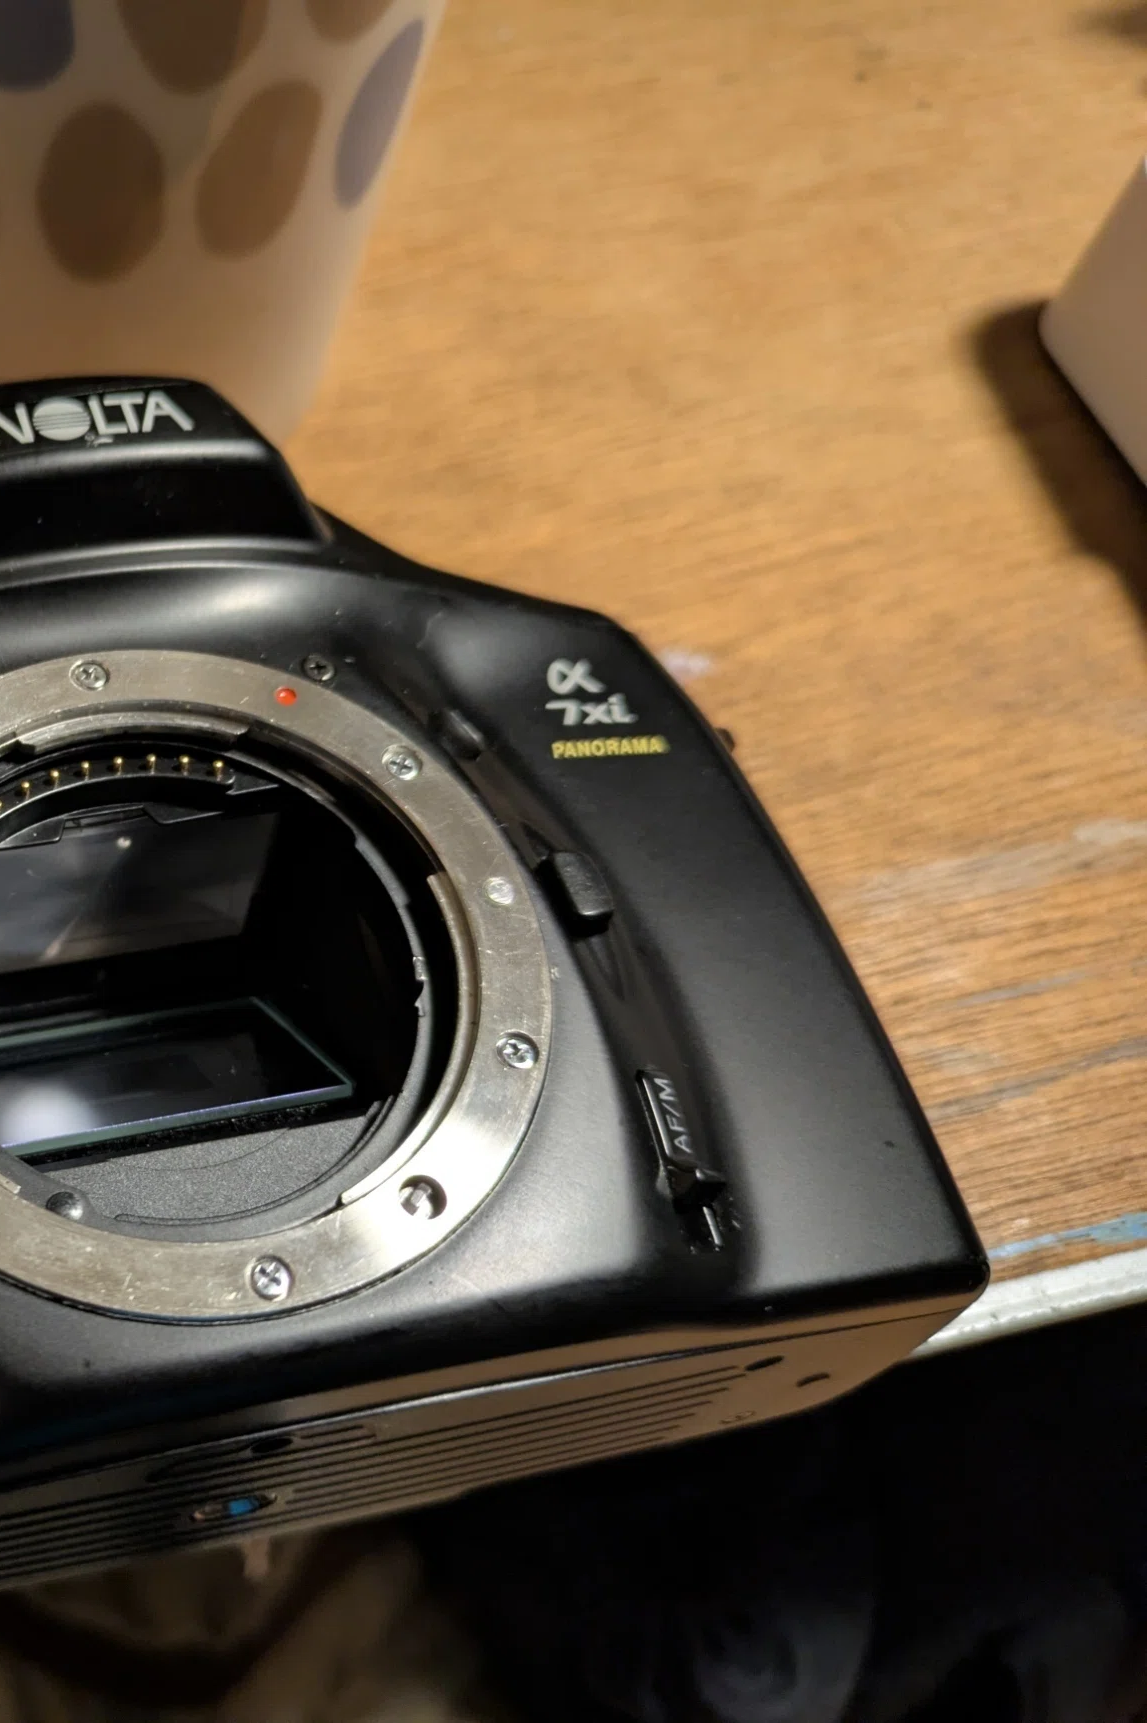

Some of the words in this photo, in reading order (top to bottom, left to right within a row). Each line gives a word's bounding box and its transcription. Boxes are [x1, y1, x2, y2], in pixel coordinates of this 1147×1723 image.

[545, 693, 639, 726] 7xi
[551, 735, 670, 759] PANORAMA
[653, 1077, 693, 1153] AF/M
